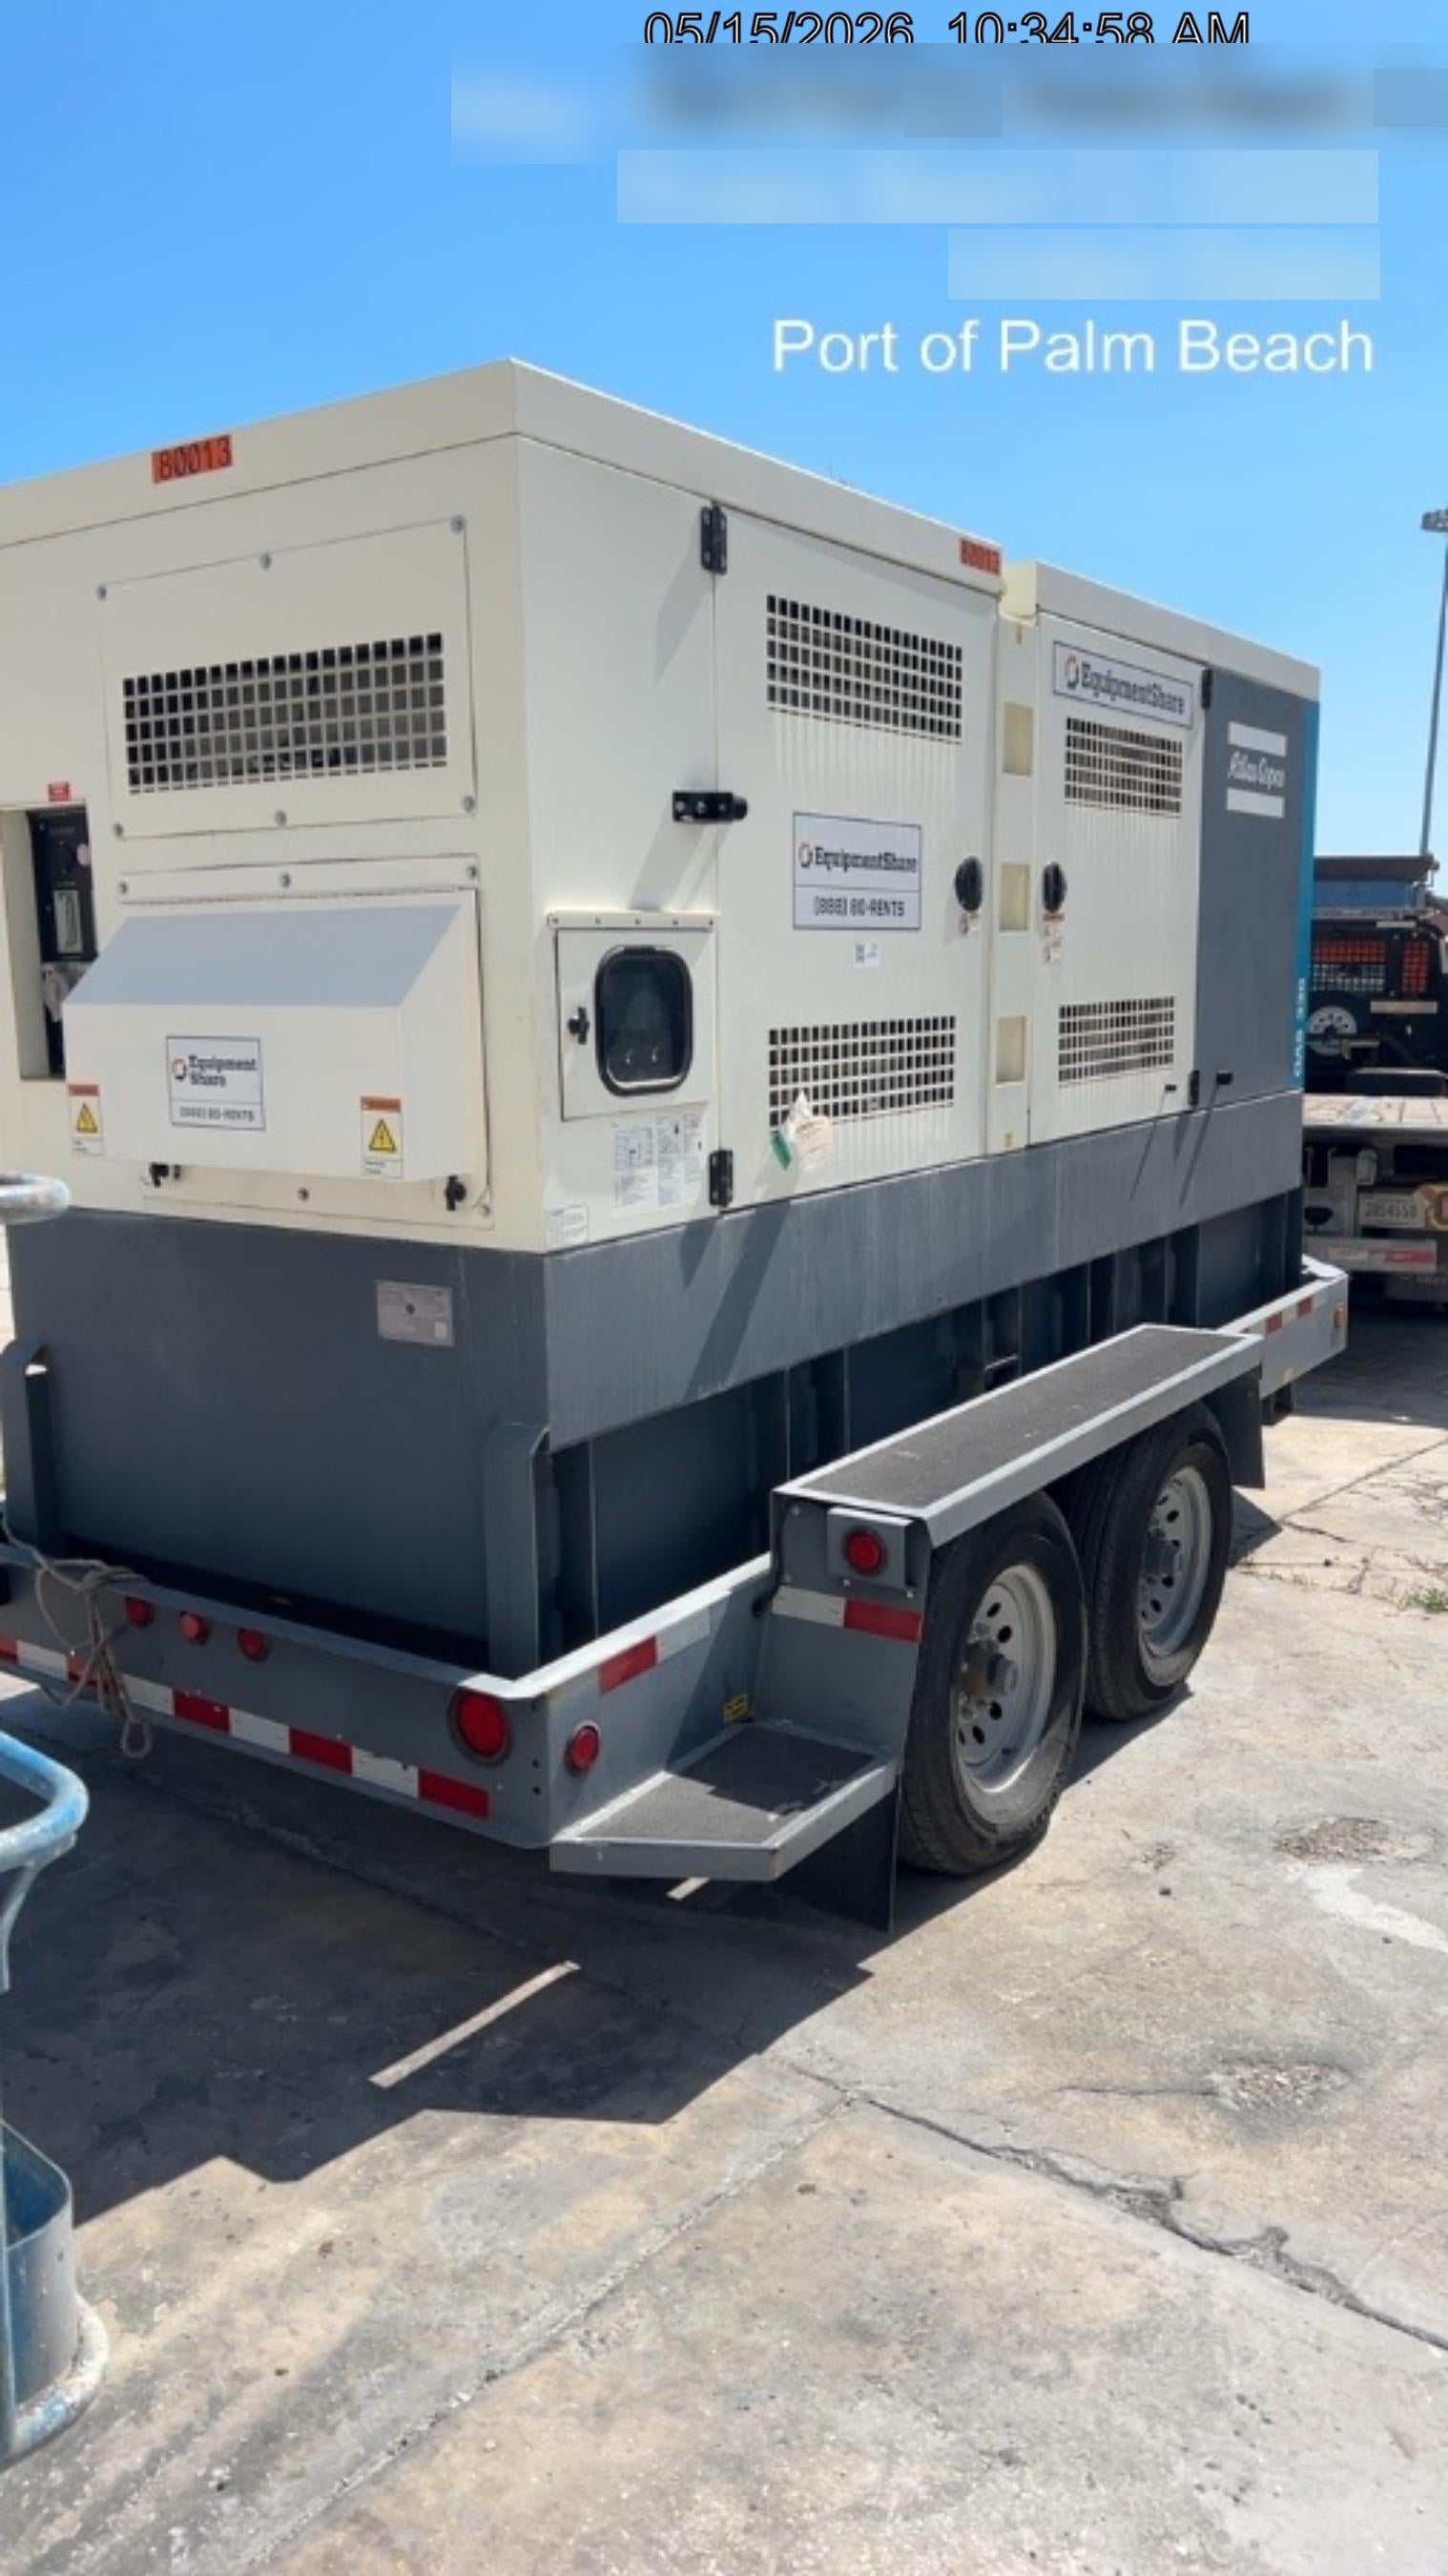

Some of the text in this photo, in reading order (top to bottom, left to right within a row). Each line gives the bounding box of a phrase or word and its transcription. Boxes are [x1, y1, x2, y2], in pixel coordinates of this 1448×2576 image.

[1080, 660, 1186, 716] EquipmentShare
[815, 845, 917, 874] EquipmentShare
[189, 1053, 258, 1074] Equipment
